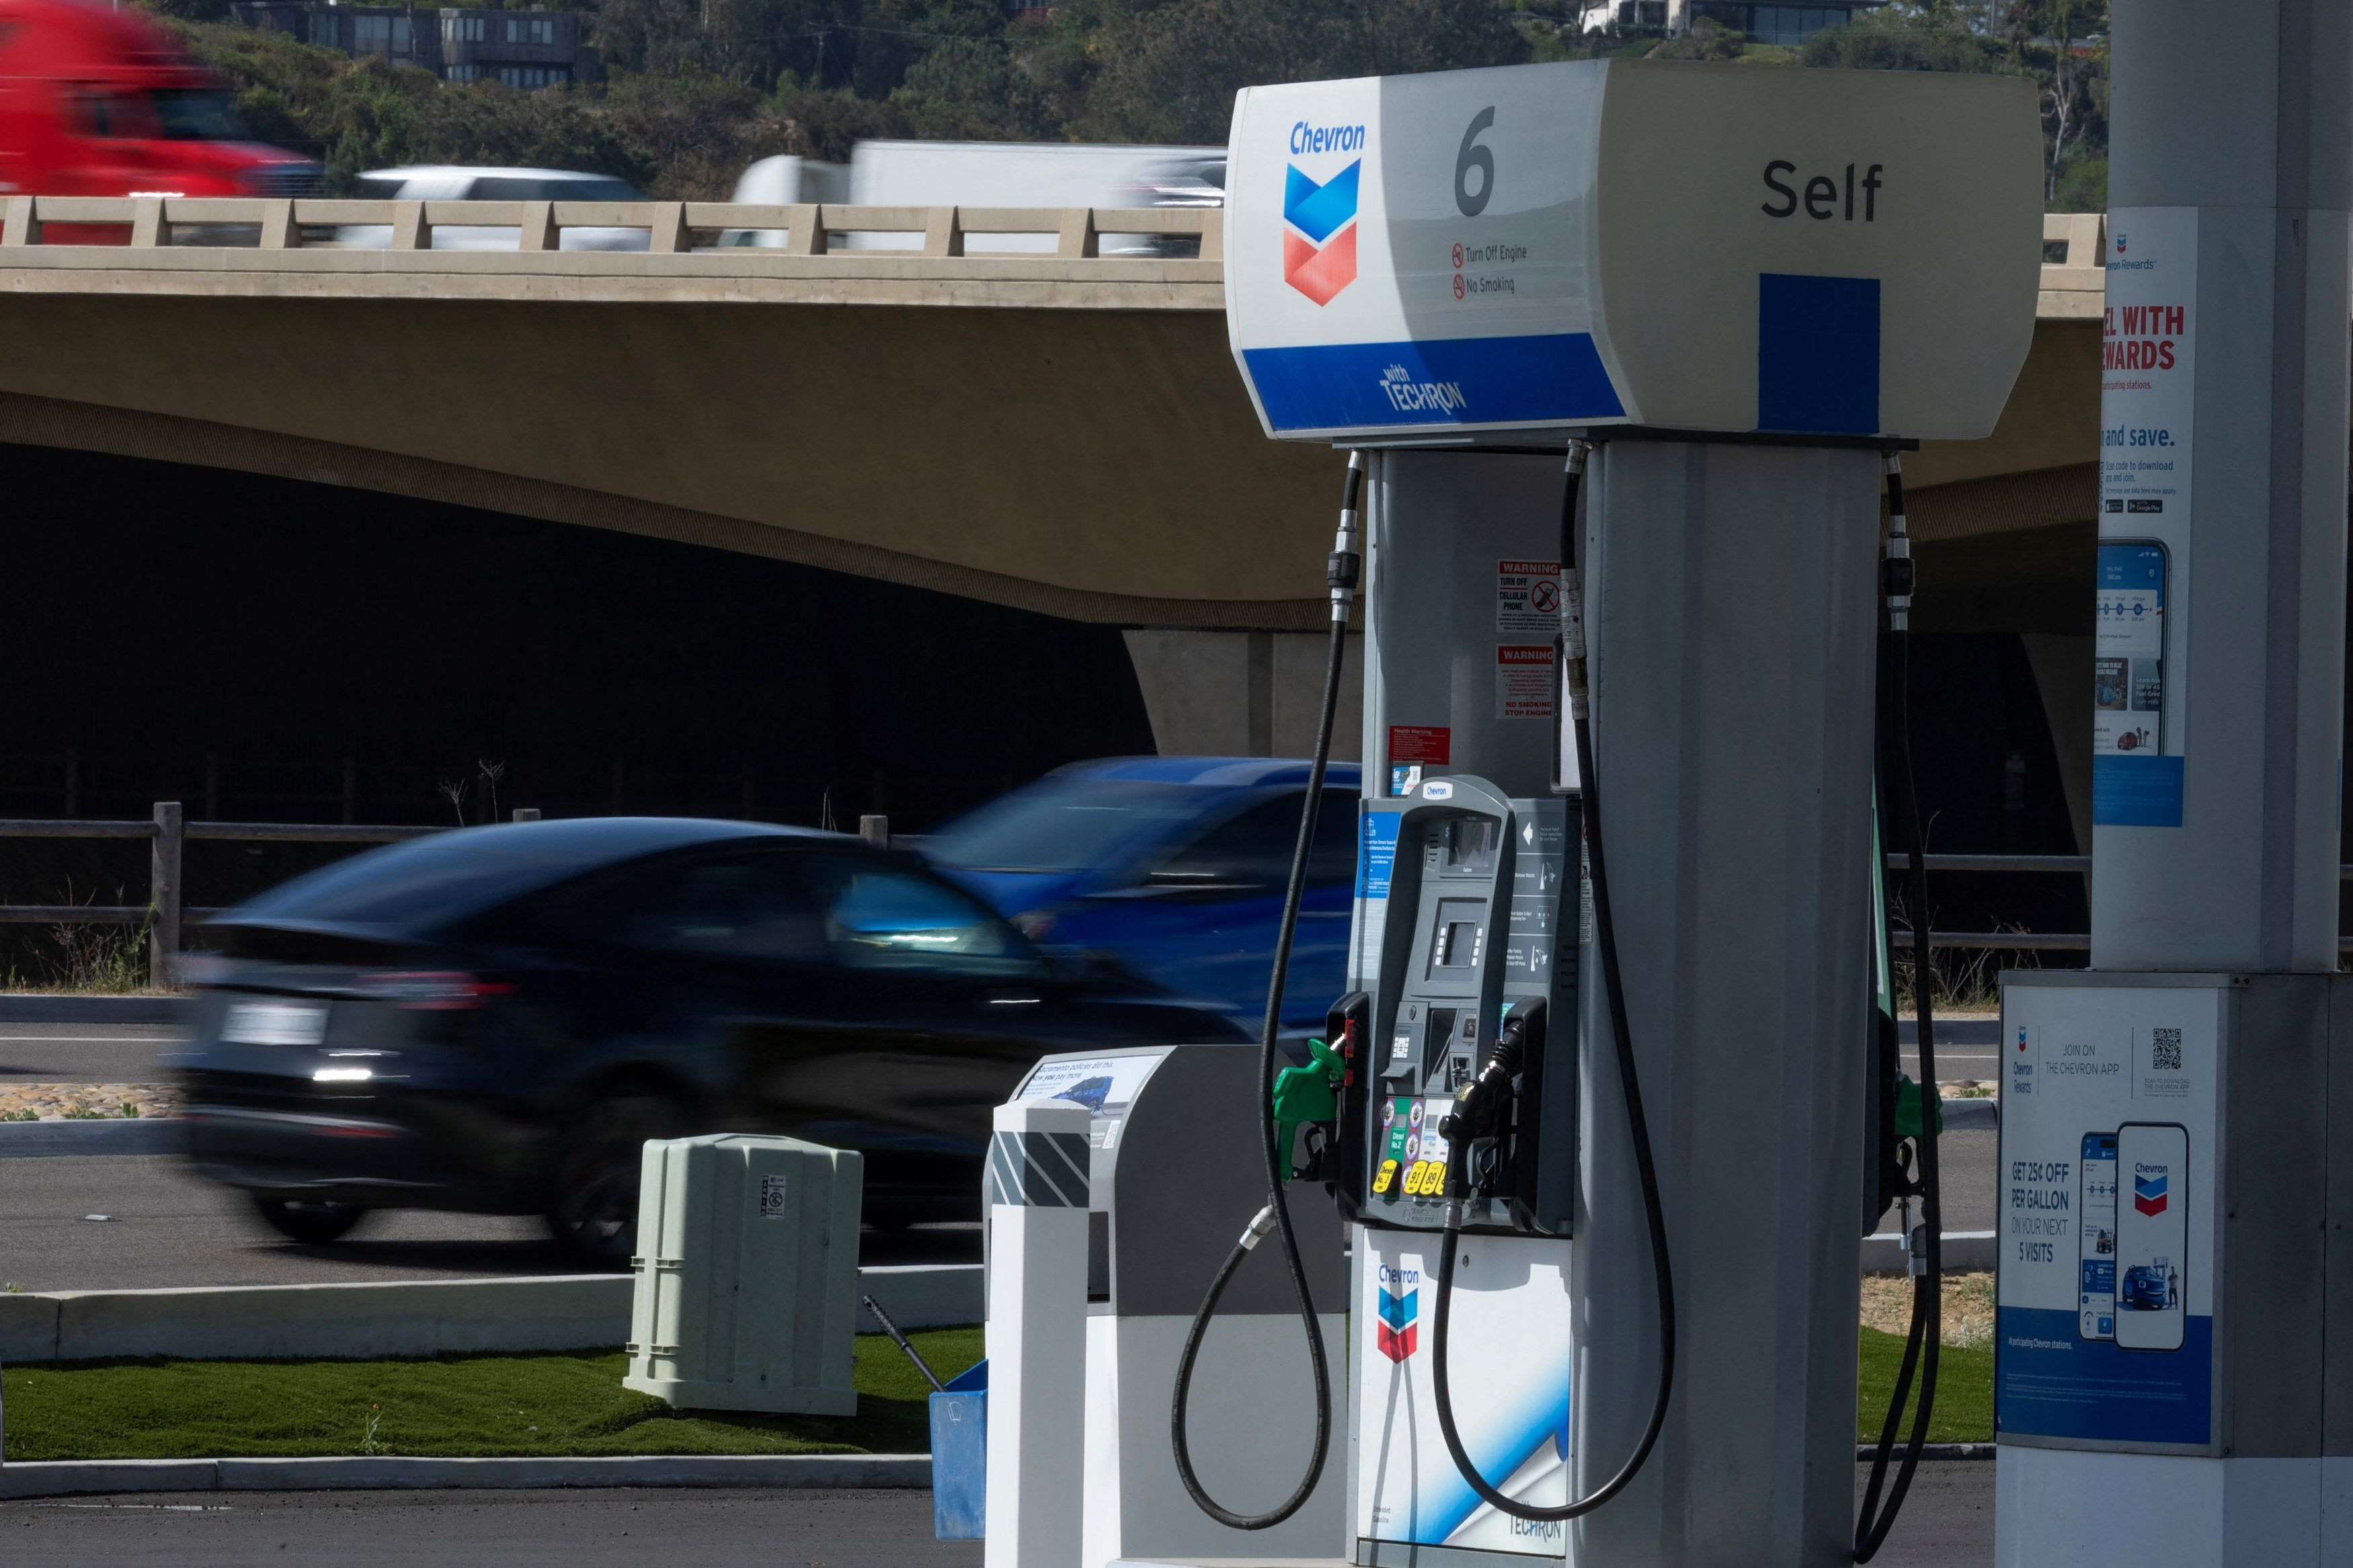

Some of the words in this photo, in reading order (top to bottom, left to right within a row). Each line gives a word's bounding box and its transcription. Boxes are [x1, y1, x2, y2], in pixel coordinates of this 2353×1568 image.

[1290, 120, 1365, 155] Chevron
[1454, 105, 1496, 217] 6
[1761, 159, 1883, 222] Self
[1466, 246, 1484, 263] Turn
[1485, 245, 1499, 261] Off
[1500, 244, 1527, 263] Engine
[1466, 277, 1479, 293] No
[1480, 276, 1515, 295] Smoking
[2122, 306, 2184, 335] WITH
[2102, 340, 2176, 370] EWARDS
[1384, 363, 1410, 382] with
[2126, 379, 2153, 390] stations.
[1379, 378, 1468, 416] TECHRON
[2106, 423, 2124, 447] and
[2129, 428, 2175, 447] save.
[2116, 460, 2128, 470] code
[2129, 461, 2137, 470] to
[2138, 460, 2173, 471] download
[2113, 472, 2122, 483] and
[2122, 472, 2136, 485] join.
[1503, 563, 1558, 573] WARNING
[1501, 577, 1515, 586] TURN
[1517, 577, 1527, 586] OFF
[1499, 591, 1527, 600] CELLULAR
[1503, 602, 1523, 611] PHONE
[1504, 651, 1554, 659] WARNING
[1427, 786, 1447, 795] Chevron
[1445, 826, 1449, 838] $
[2063, 1044, 2081, 1057] JOIN
[2082, 1044, 2096, 1057] ON
[2013, 1063, 2033, 1076] Chevron
[2046, 1061, 2059, 1075] THE
[2060, 1062, 2098, 1075] CHEVRON
[2100, 1063, 2120, 1076] APP
[2014, 1079, 2032, 1094] Rewards
[1392, 1132, 1404, 1140] Diesel
[2012, 1161, 2026, 1182] GET
[2028, 1161, 2044, 1182] 25¢
[2045, 1162, 2070, 1184] OFF
[2135, 1162, 2168, 1175] Chevron
[1410, 1172, 1421, 1184] 91
[1425, 1172, 1437, 1184] 89
[2011, 1188, 2025, 1208] PER
[2027, 1189, 2069, 1211] GALLON
[2011, 1216, 2020, 1234] ON
[2022, 1216, 2041, 1235] YOUR
[2043, 1218, 2069, 1236] NEXT
[2019, 1241, 2024, 1262] 5
[2025, 1241, 2054, 1263] VISITS
[1378, 1264, 1419, 1284] Chevron
[2033, 1338, 2051, 1349] Chevron
[2051, 1339, 2073, 1350] stations.
